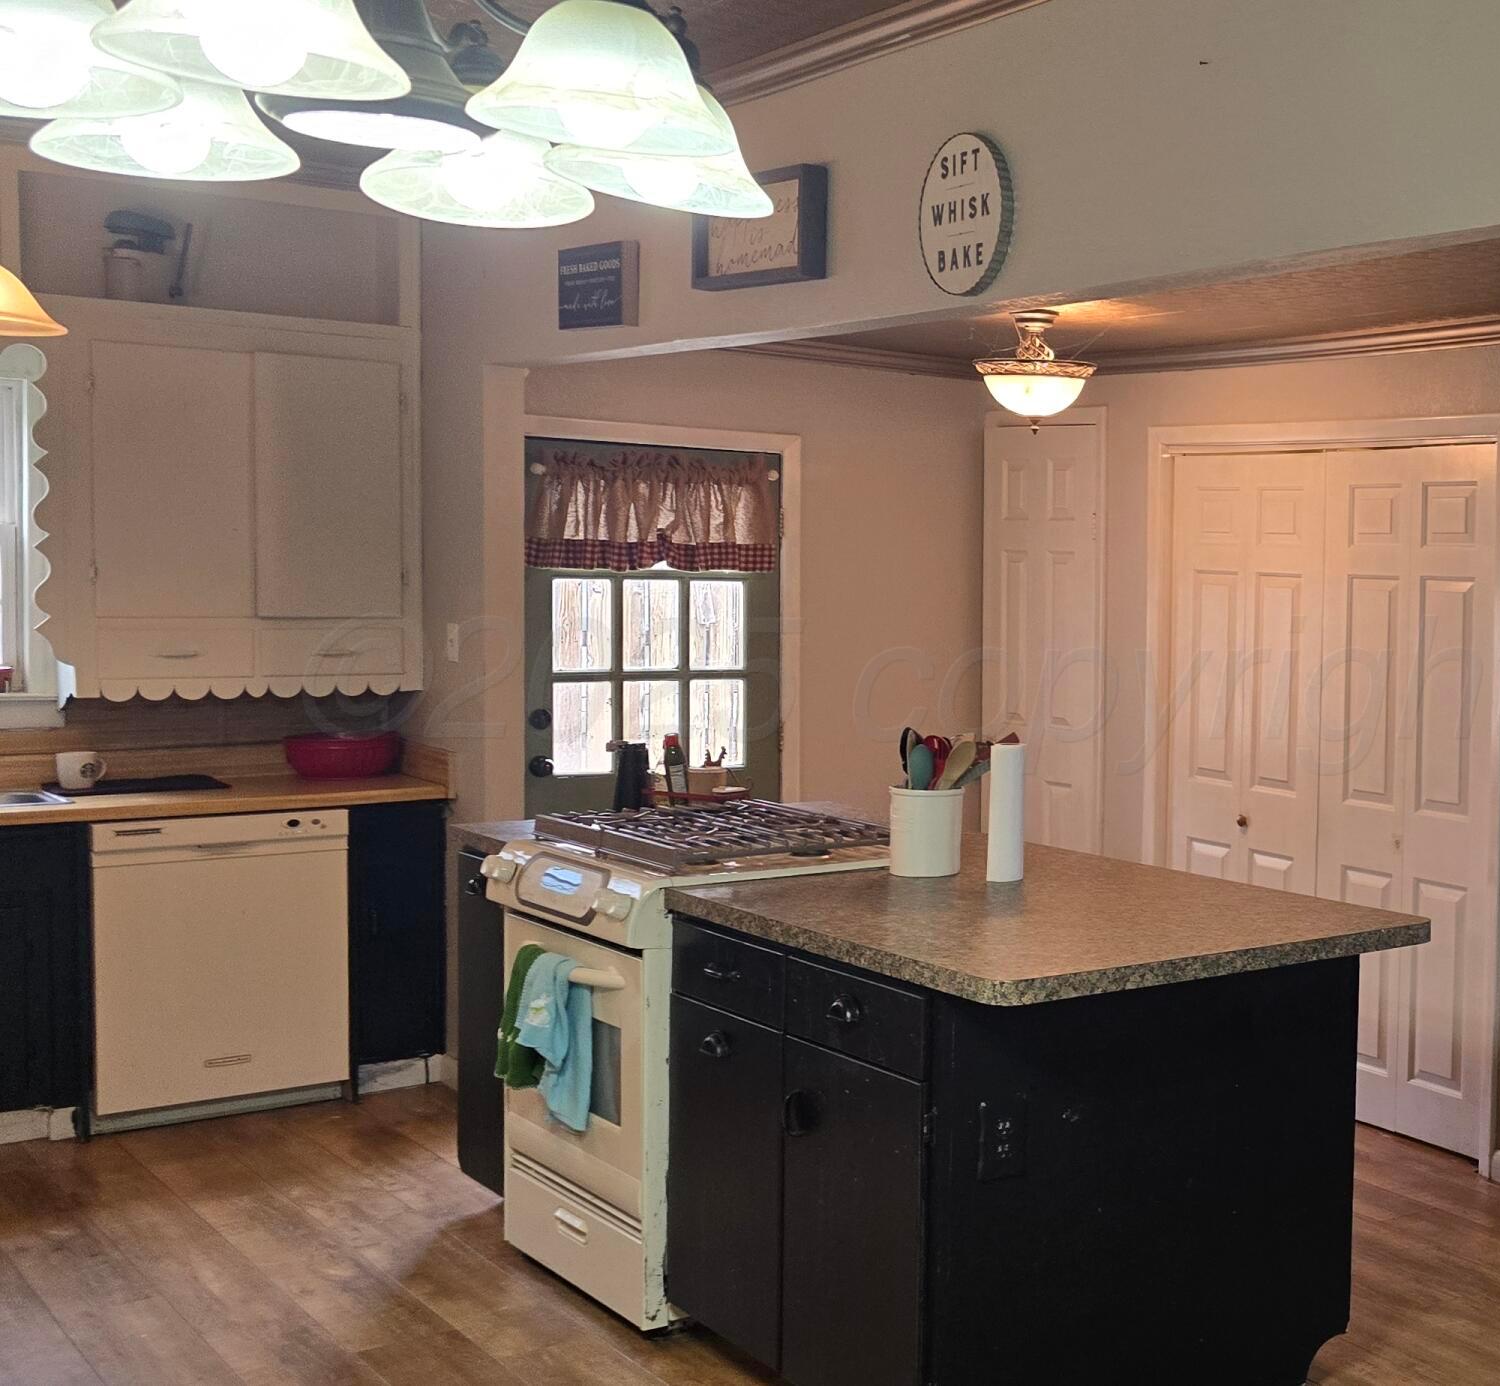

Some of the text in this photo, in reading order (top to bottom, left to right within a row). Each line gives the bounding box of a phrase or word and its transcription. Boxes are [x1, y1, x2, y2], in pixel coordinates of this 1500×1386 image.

[940, 148, 980, 180] SIFT
[931, 193, 990, 227] WHISK
[578, 261, 598, 273] BAKED
[599, 259, 620, 270] GOODS
[715, 226, 799, 276] homemad
[937, 242, 984, 273] BAKE
